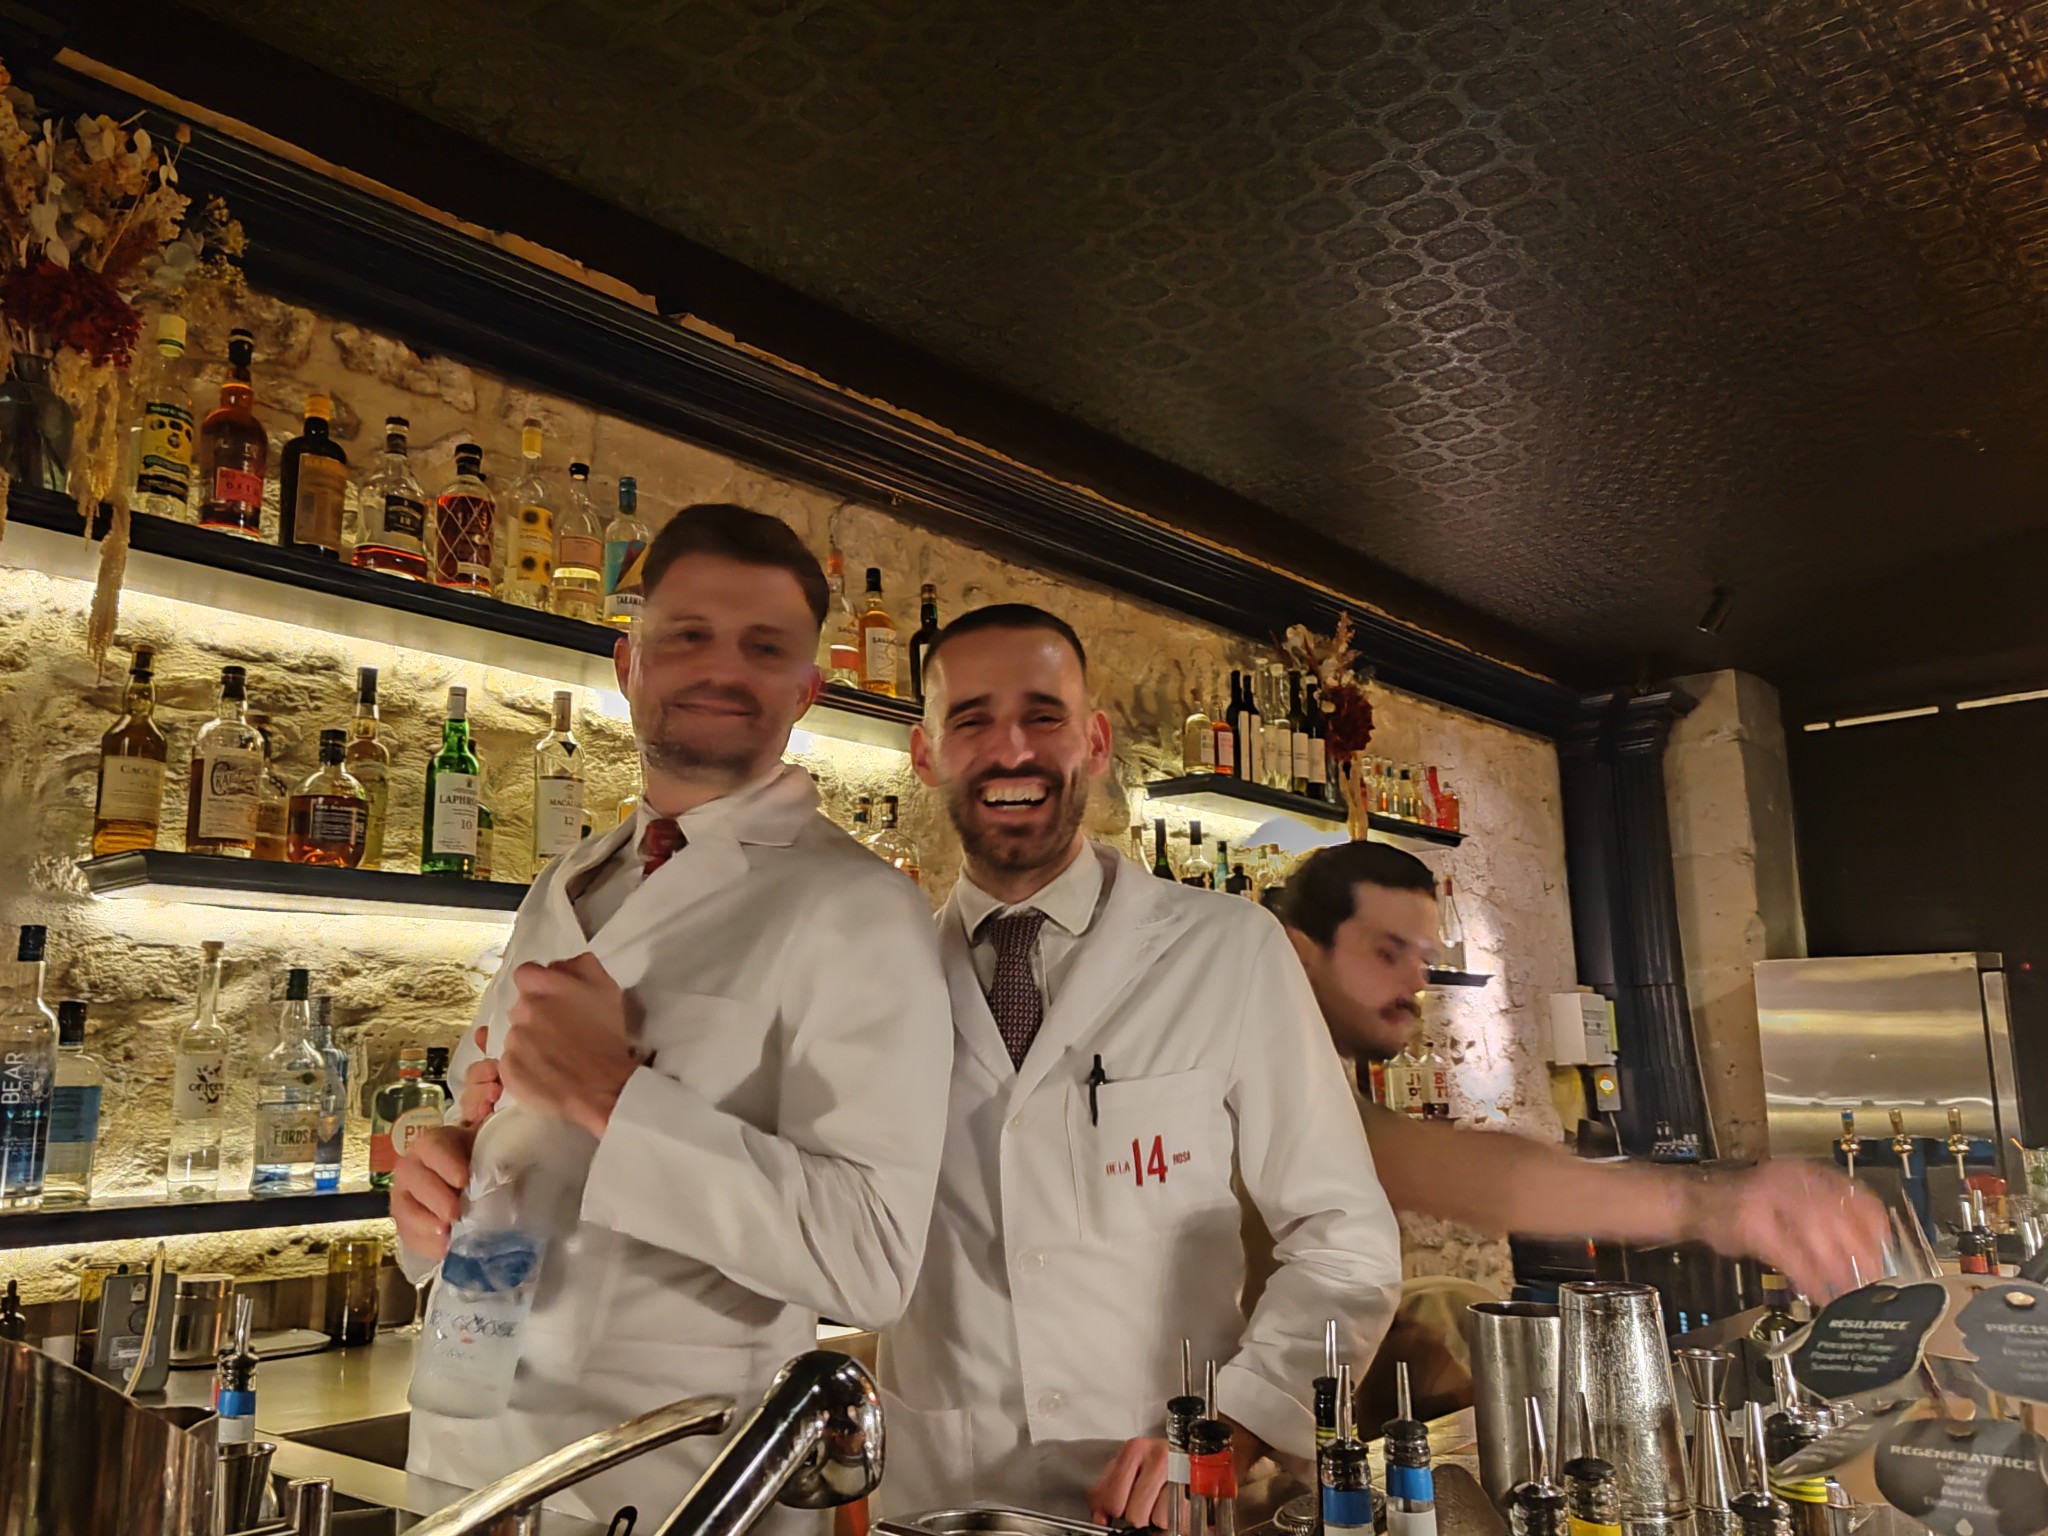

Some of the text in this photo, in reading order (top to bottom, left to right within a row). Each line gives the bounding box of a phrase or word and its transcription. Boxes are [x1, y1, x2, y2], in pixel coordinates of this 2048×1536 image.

[461, 819, 472, 830] 10
[1, 1052, 25, 1105] BEAR
[273, 1129, 308, 1146] FORDS
[1132, 1134, 1168, 1187] 14
[1173, 1151, 1191, 1165] ROSA
